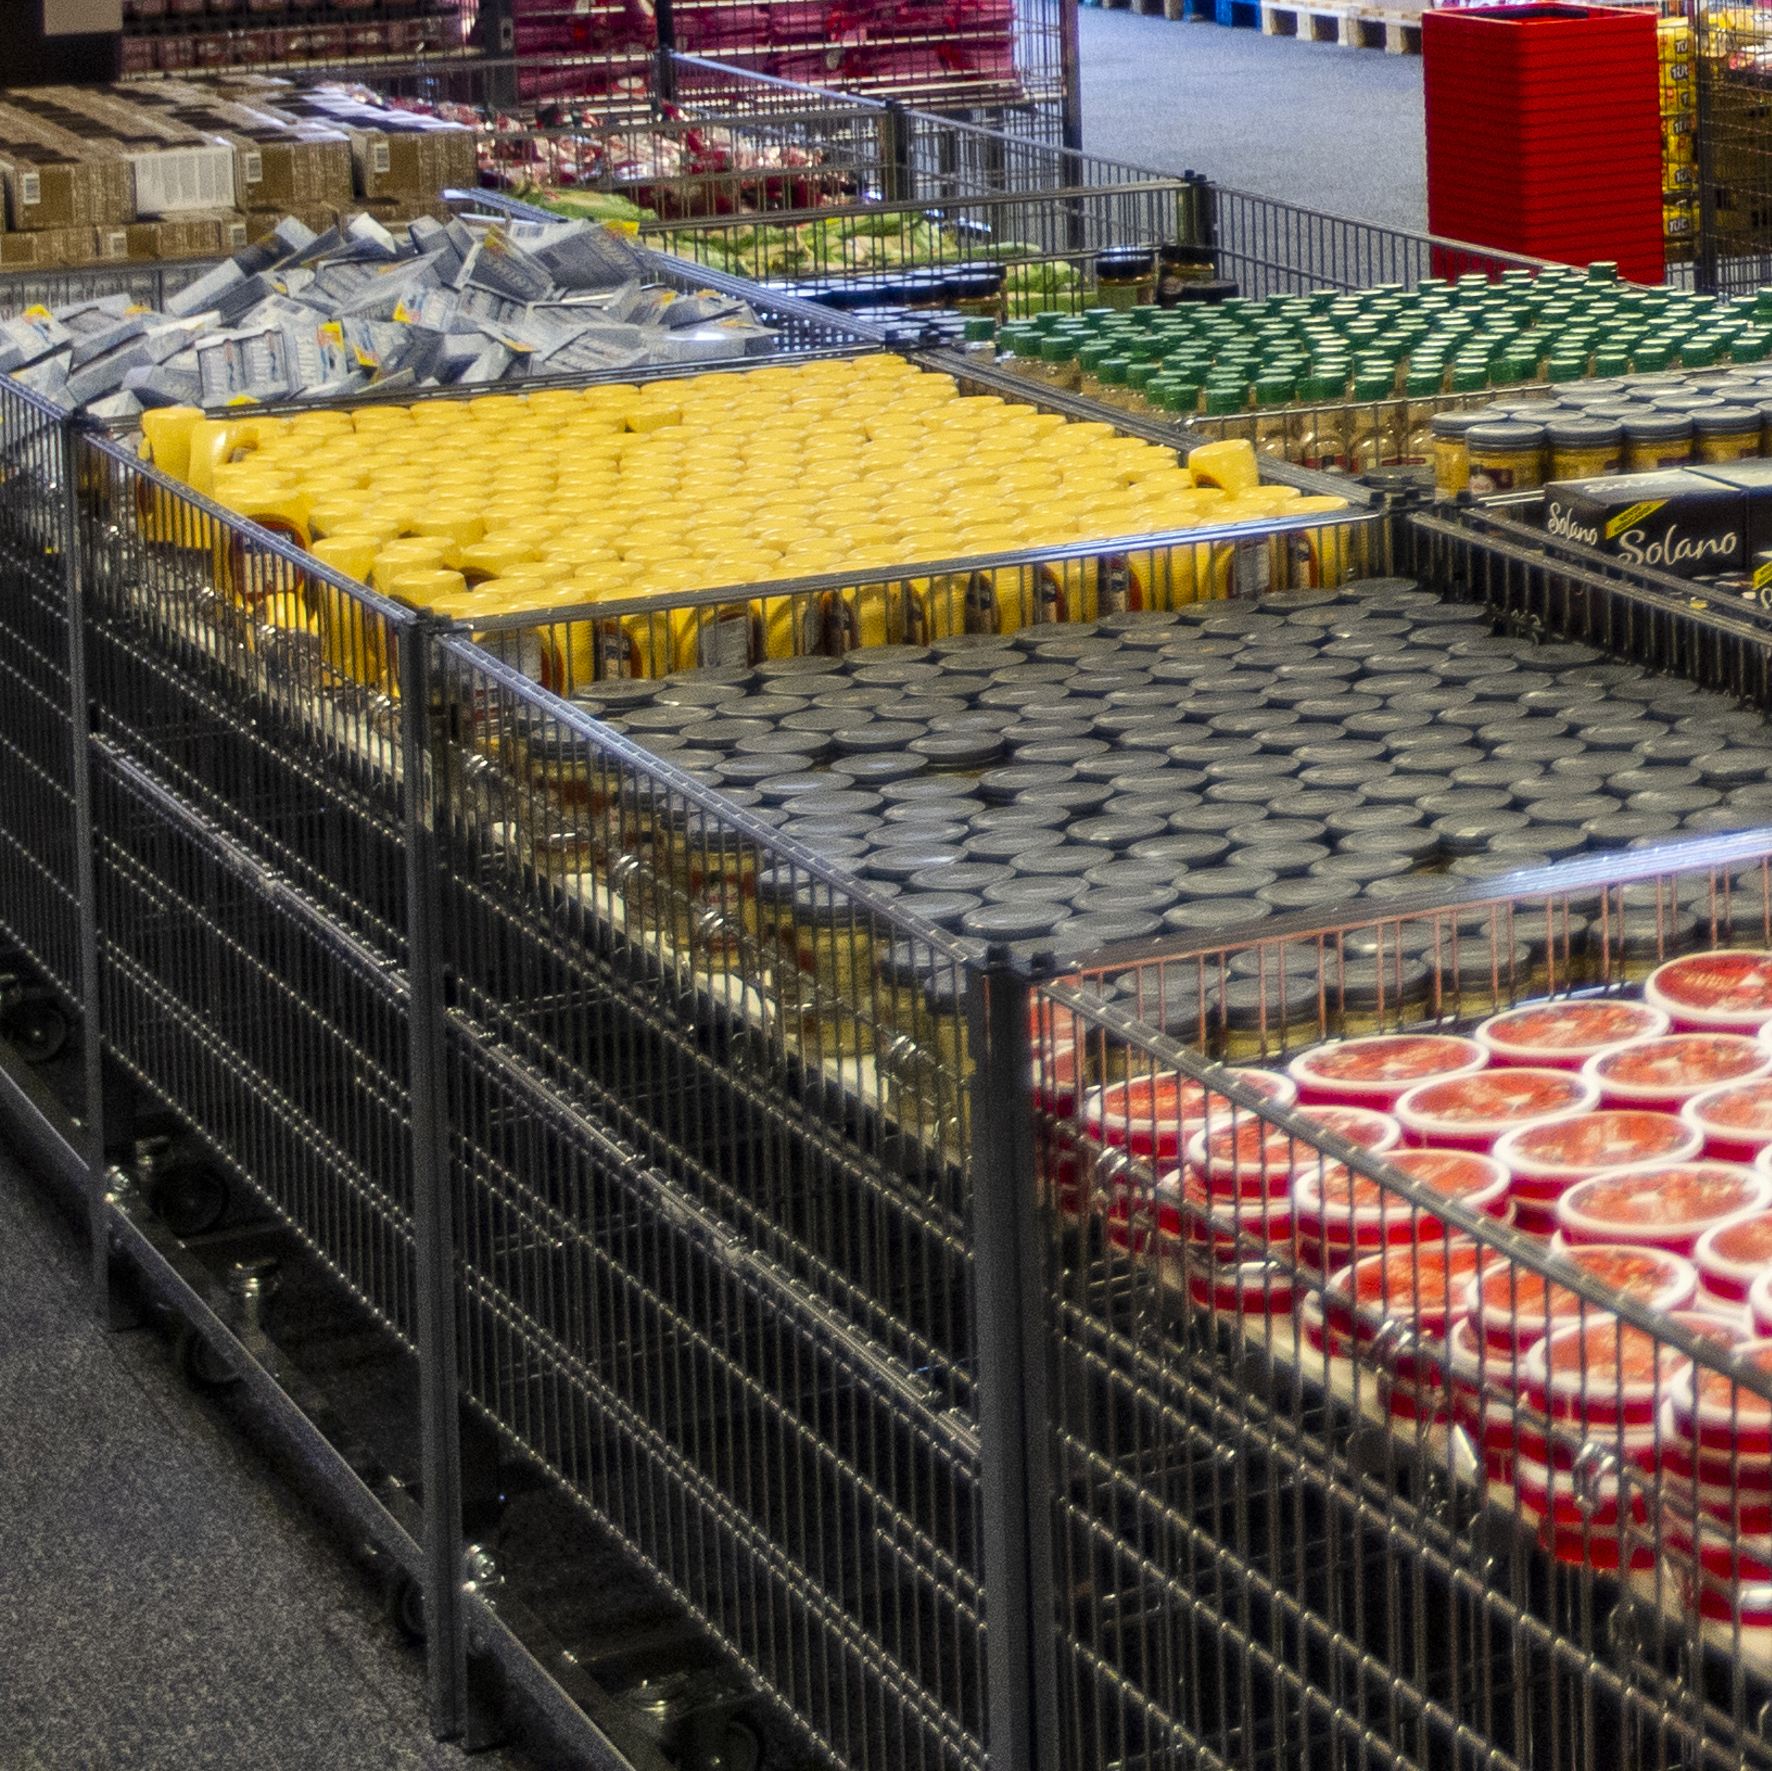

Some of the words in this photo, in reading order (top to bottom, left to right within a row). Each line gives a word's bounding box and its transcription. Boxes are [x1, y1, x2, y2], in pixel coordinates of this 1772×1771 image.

[1669, 216, 1688, 232] TUC
[1548, 502, 1598, 547] Solano
[1617, 523, 1738, 566] Solano
